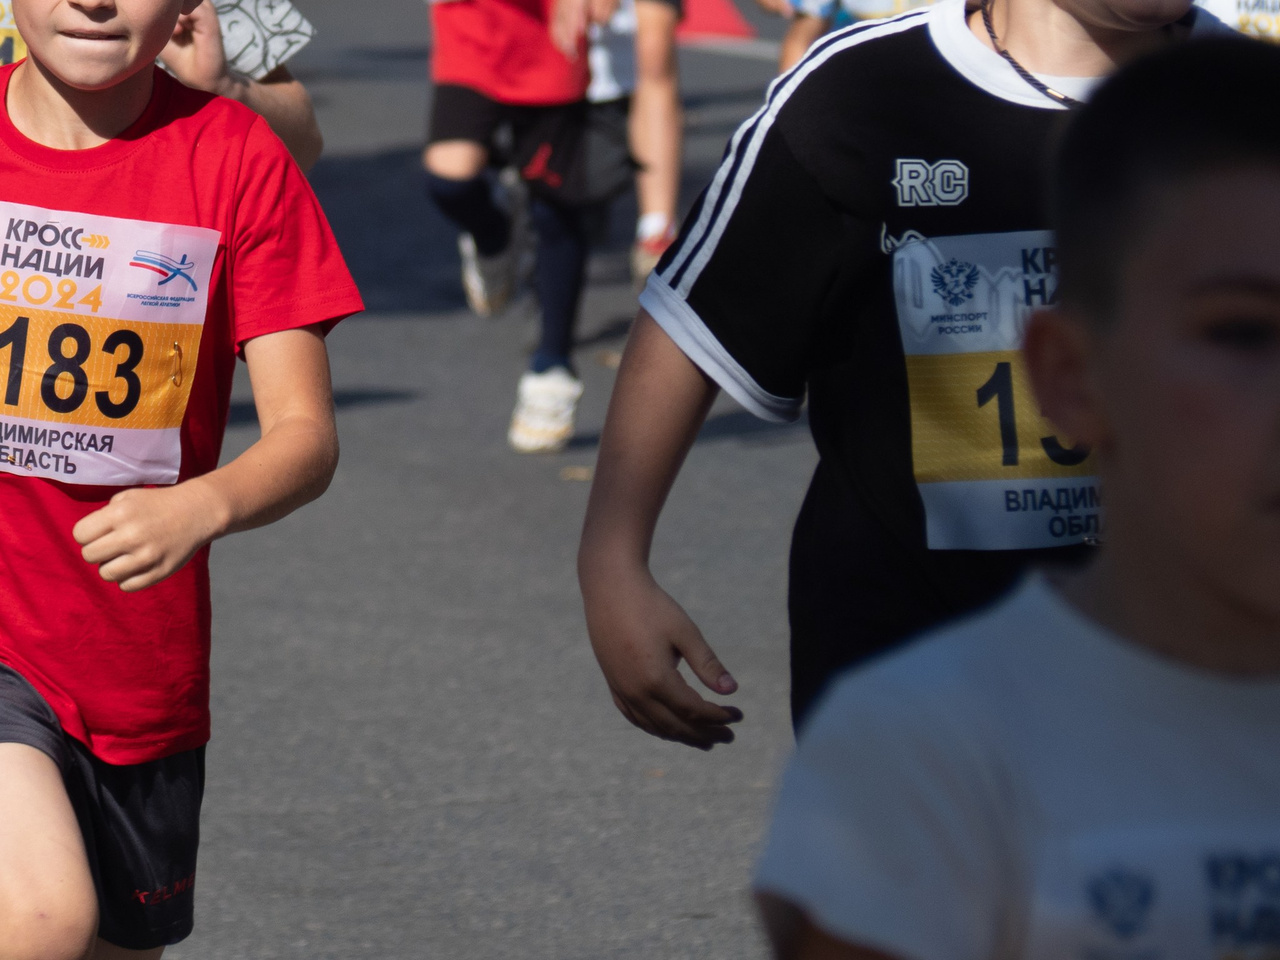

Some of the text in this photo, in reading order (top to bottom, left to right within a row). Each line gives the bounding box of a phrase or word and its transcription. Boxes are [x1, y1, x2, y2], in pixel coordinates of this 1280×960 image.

[5, 218, 84, 251] КРОСС
[0, 243, 105, 280] НАЦИИ
[930, 311, 988, 325] МИНСПОРТ
[938, 323, 983, 335] РОССИИ
